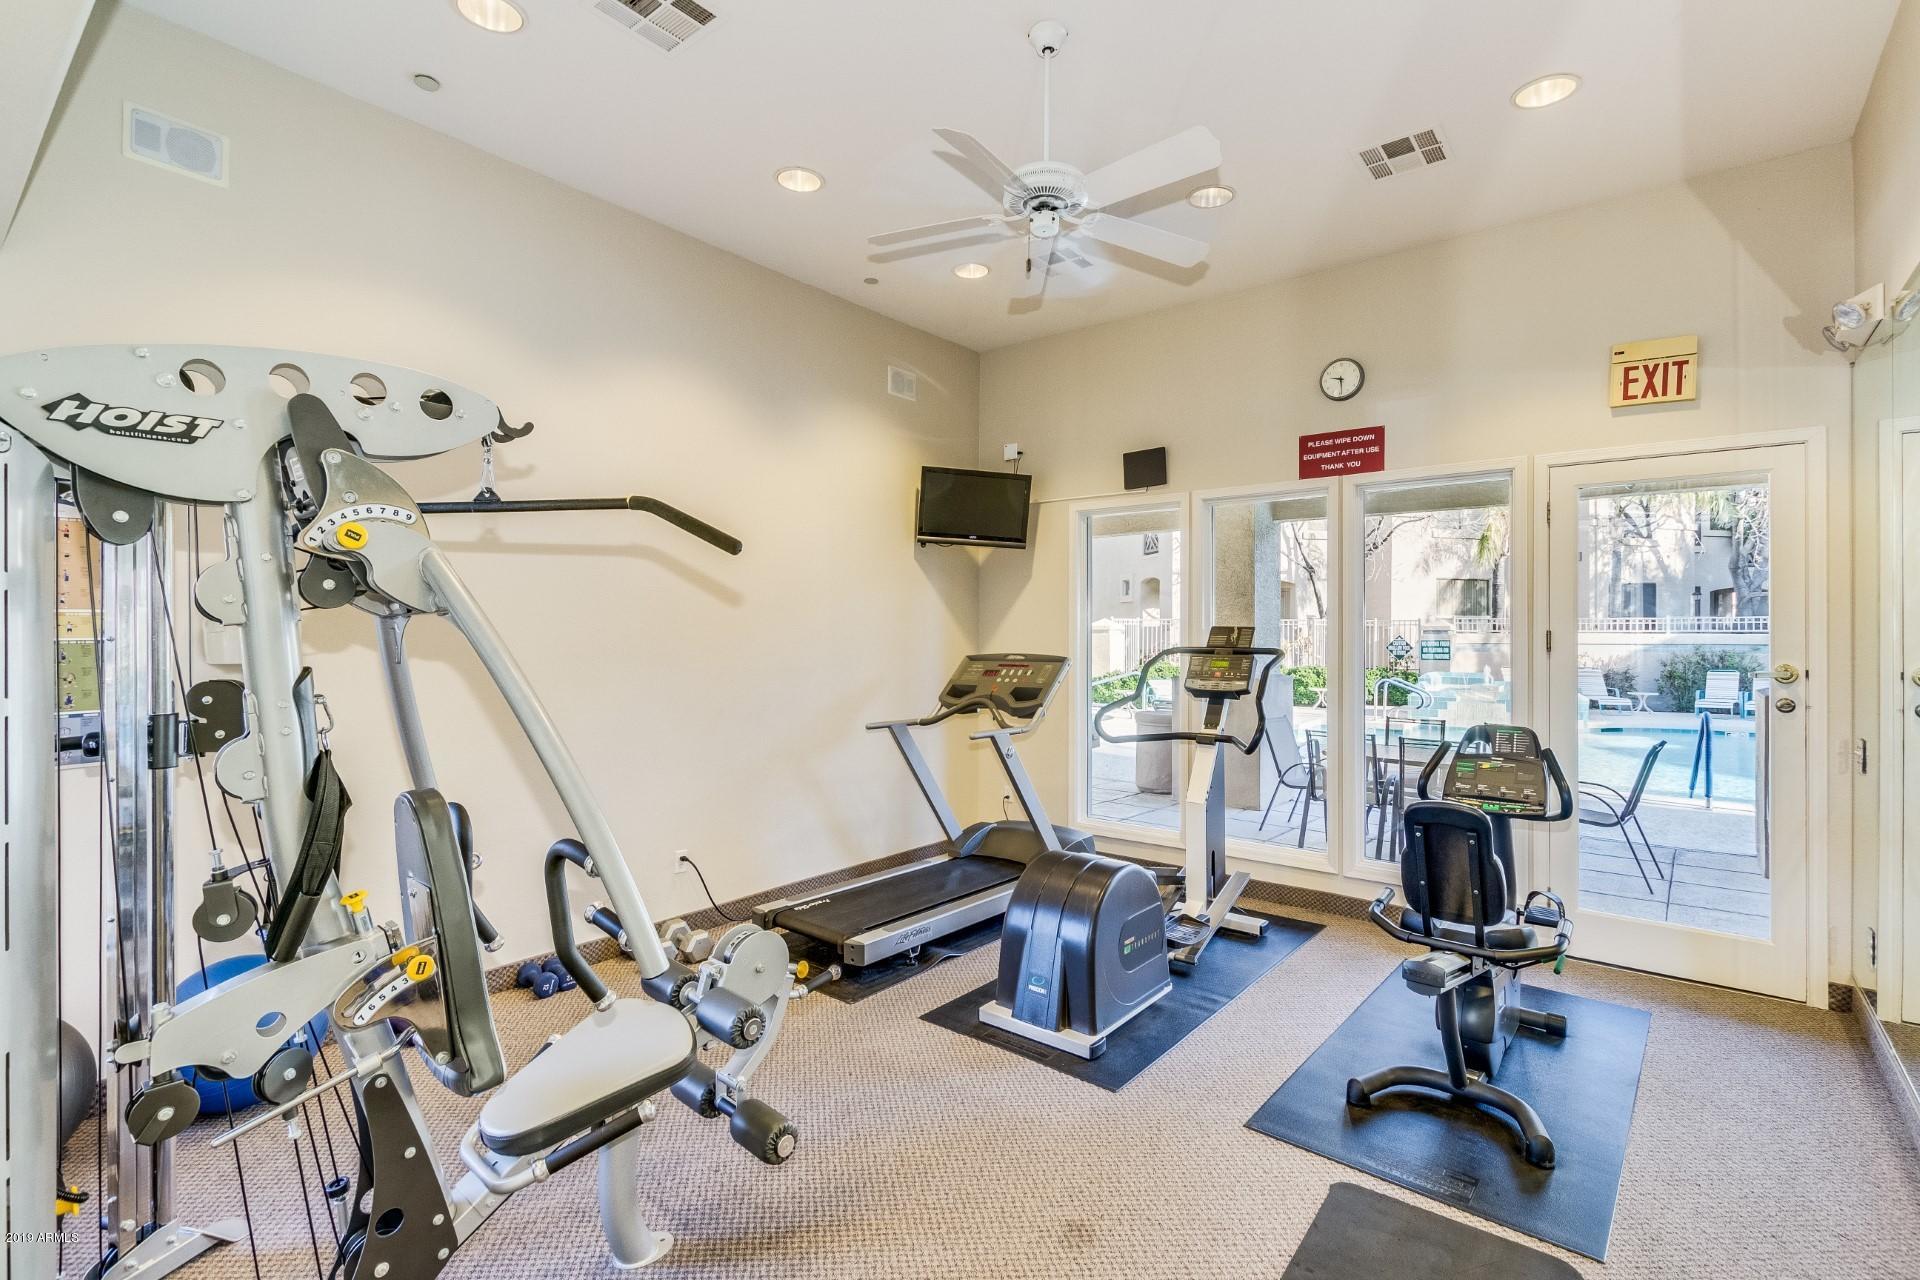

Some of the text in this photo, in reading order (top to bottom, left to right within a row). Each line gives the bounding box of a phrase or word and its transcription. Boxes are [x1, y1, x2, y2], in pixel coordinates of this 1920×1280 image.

[1622, 360, 1689, 401] EXIT
[49, 399, 223, 438] HOIST
[1308, 434, 1375, 448] PLEASE WIPE DOWN
[1303, 450, 1341, 460] EQUIPMENT
[1341, 448, 1364, 456] AFTER
[1320, 462, 1344, 470] THANK
